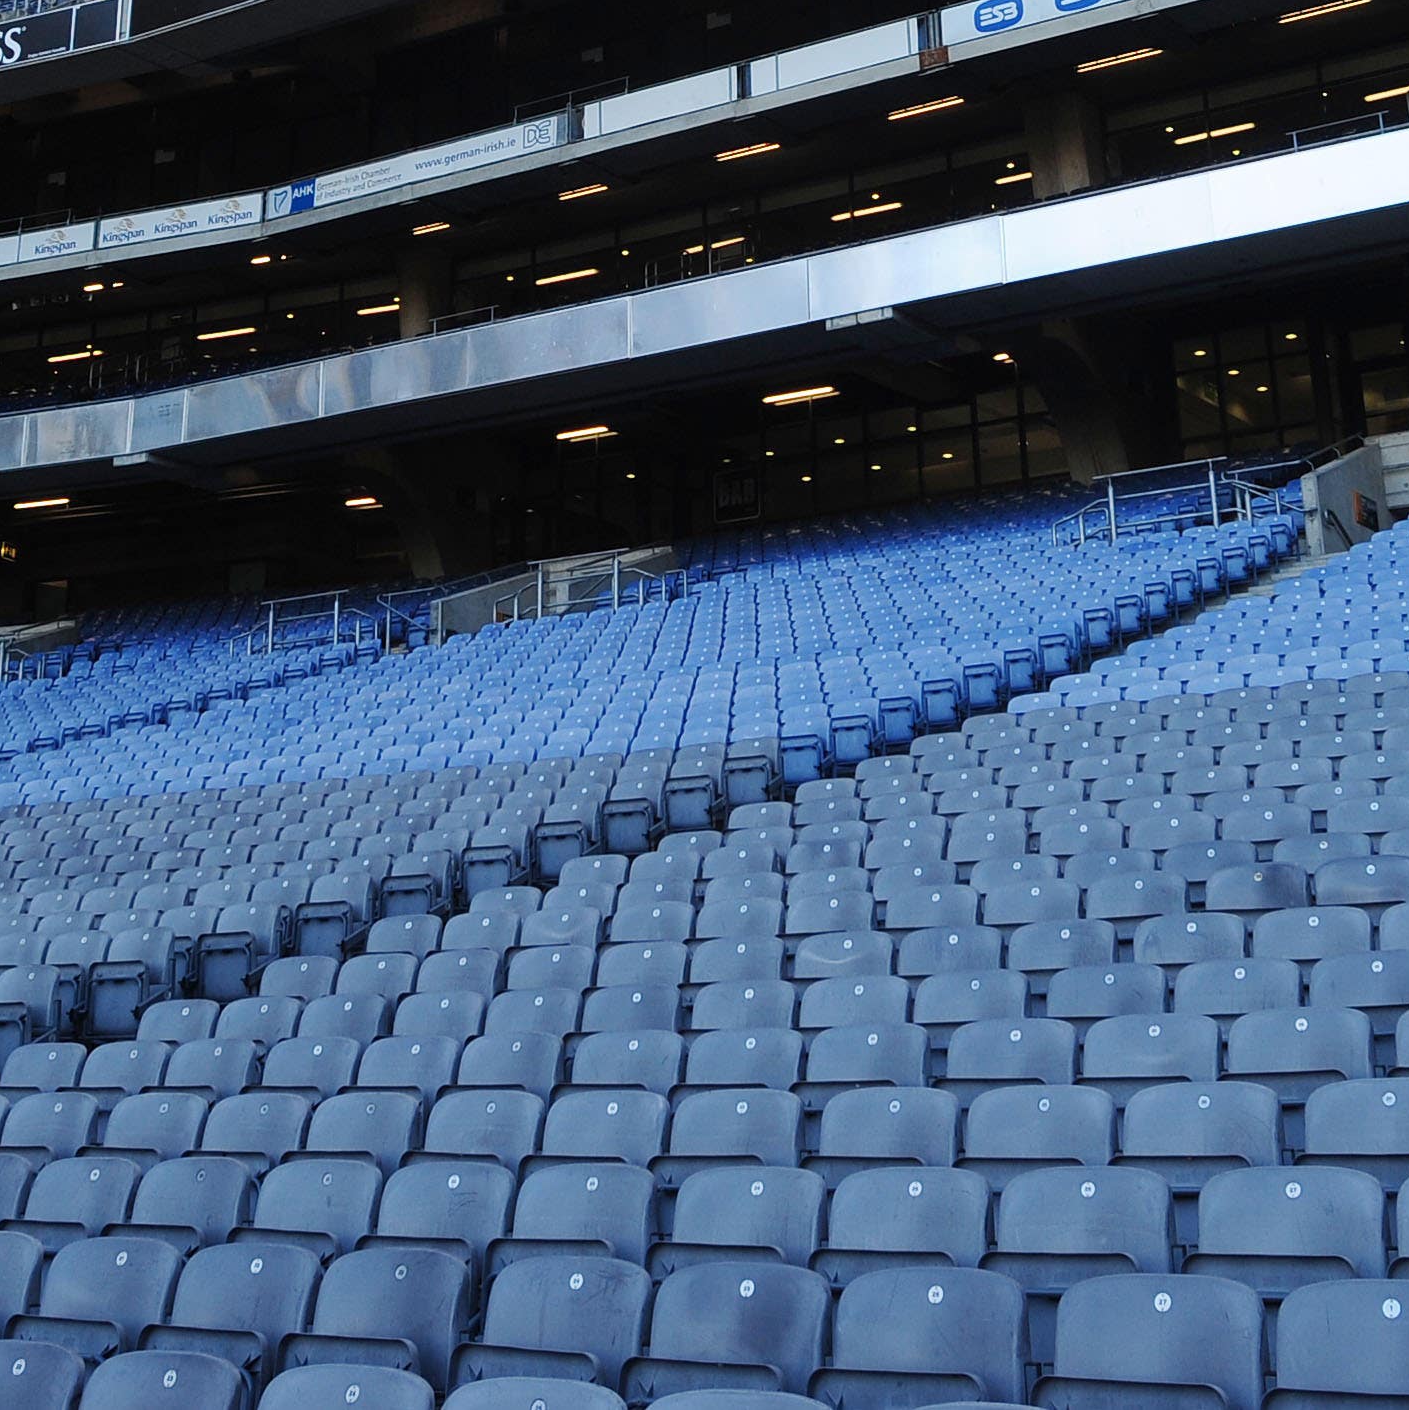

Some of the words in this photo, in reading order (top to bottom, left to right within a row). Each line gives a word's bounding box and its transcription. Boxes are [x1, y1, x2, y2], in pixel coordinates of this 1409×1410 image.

[979, 1, 1018, 27] ESB
[414, 137, 517, 170] www.german-irish.ie
[292, 184, 314, 199] AHK
[207, 209, 253, 225] Kingspan
[154, 218, 198, 234] Kingspan
[102, 227, 145, 243] Kingspan
[34, 240, 76, 255] Kingspan
